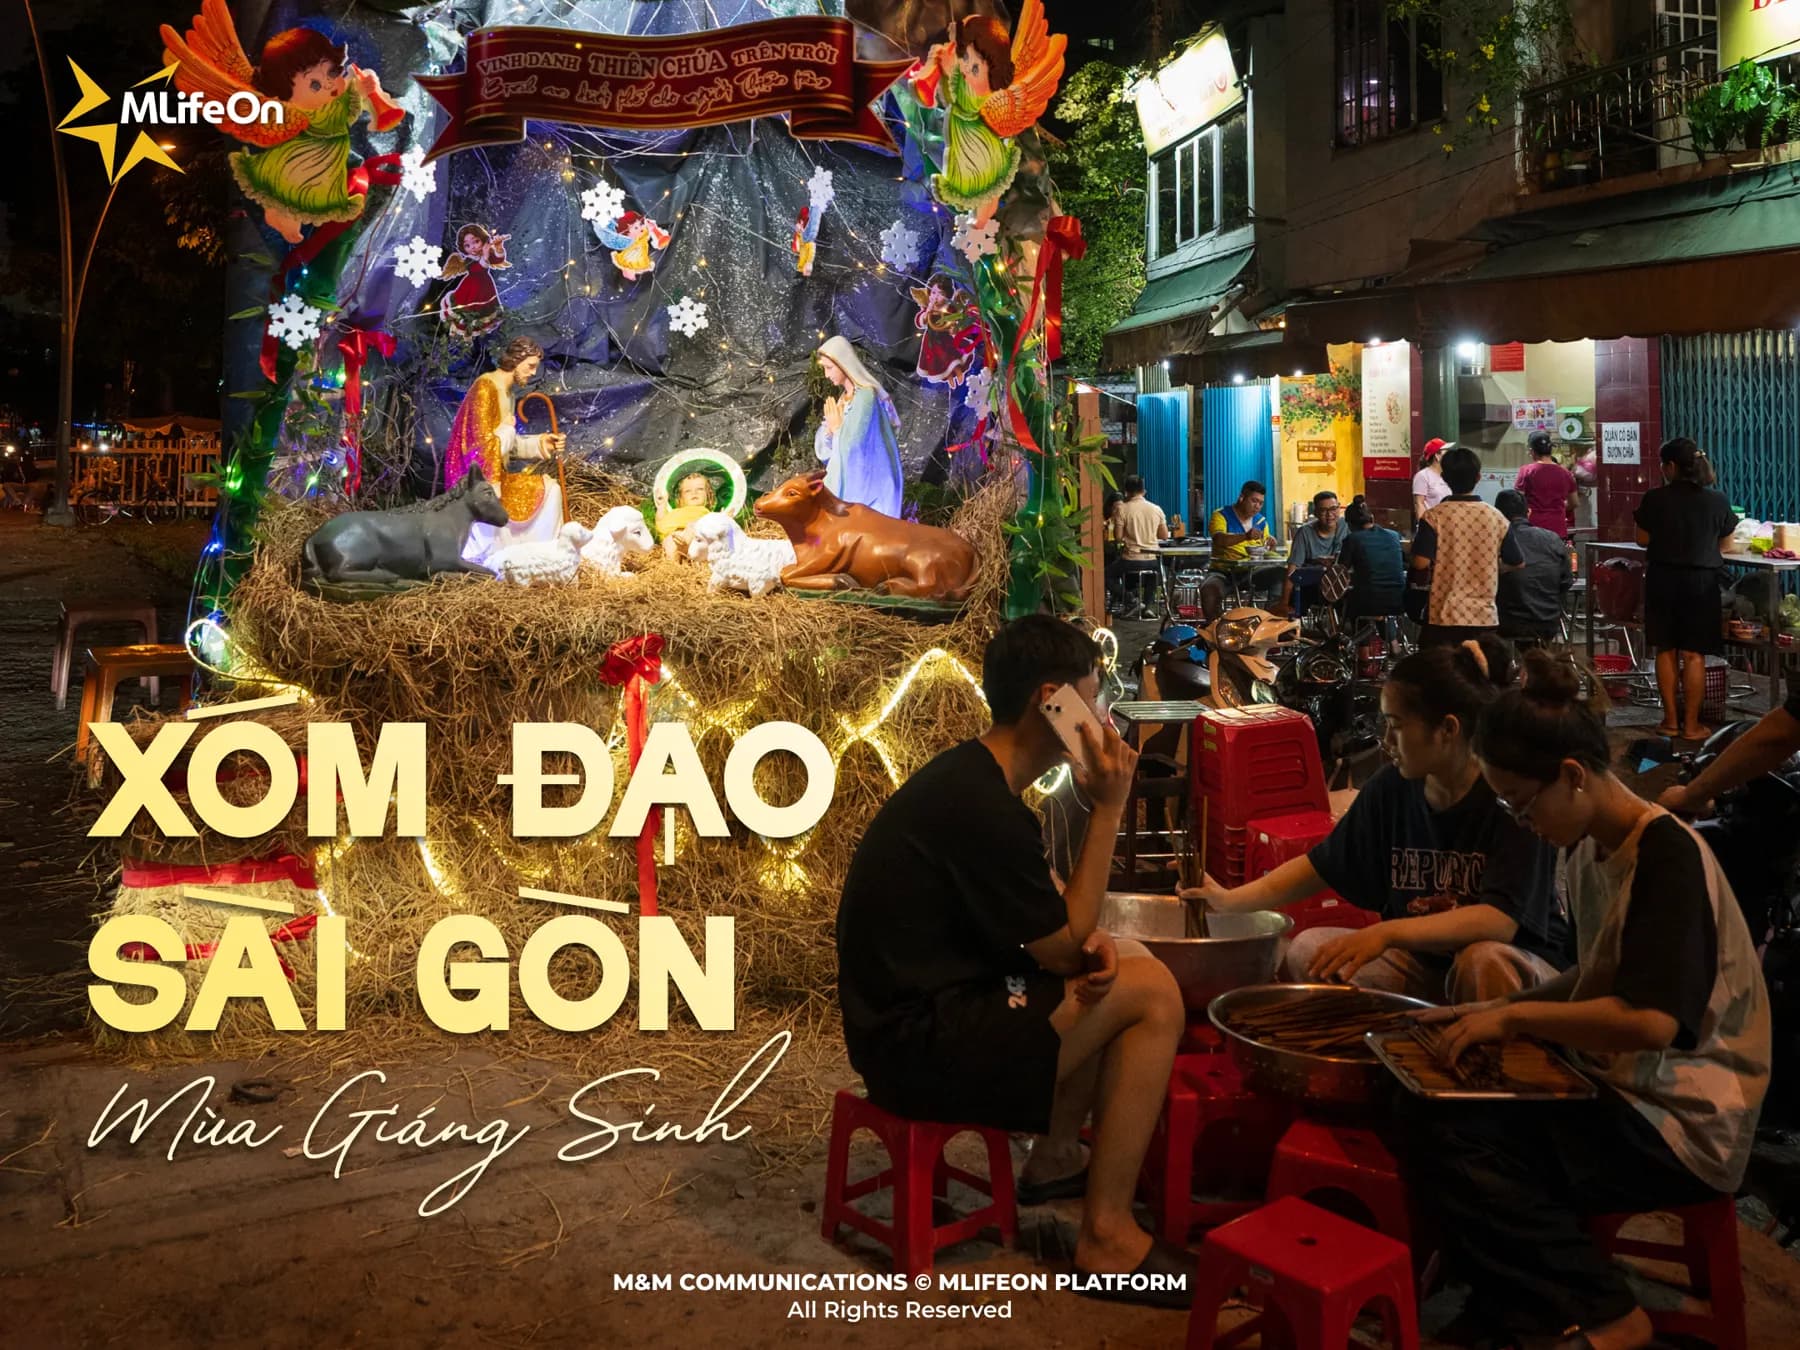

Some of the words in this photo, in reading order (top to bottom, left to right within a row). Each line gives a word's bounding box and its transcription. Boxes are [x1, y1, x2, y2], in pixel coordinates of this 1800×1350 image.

[477, 53, 524, 75] VINH
[526, 52, 582, 72] DANH
[588, 52, 658, 79] THIÊN
[660, 48, 727, 79] CHÚA
[731, 41, 786, 67] TRÊN
[788, 42, 838, 65] TRỜI
